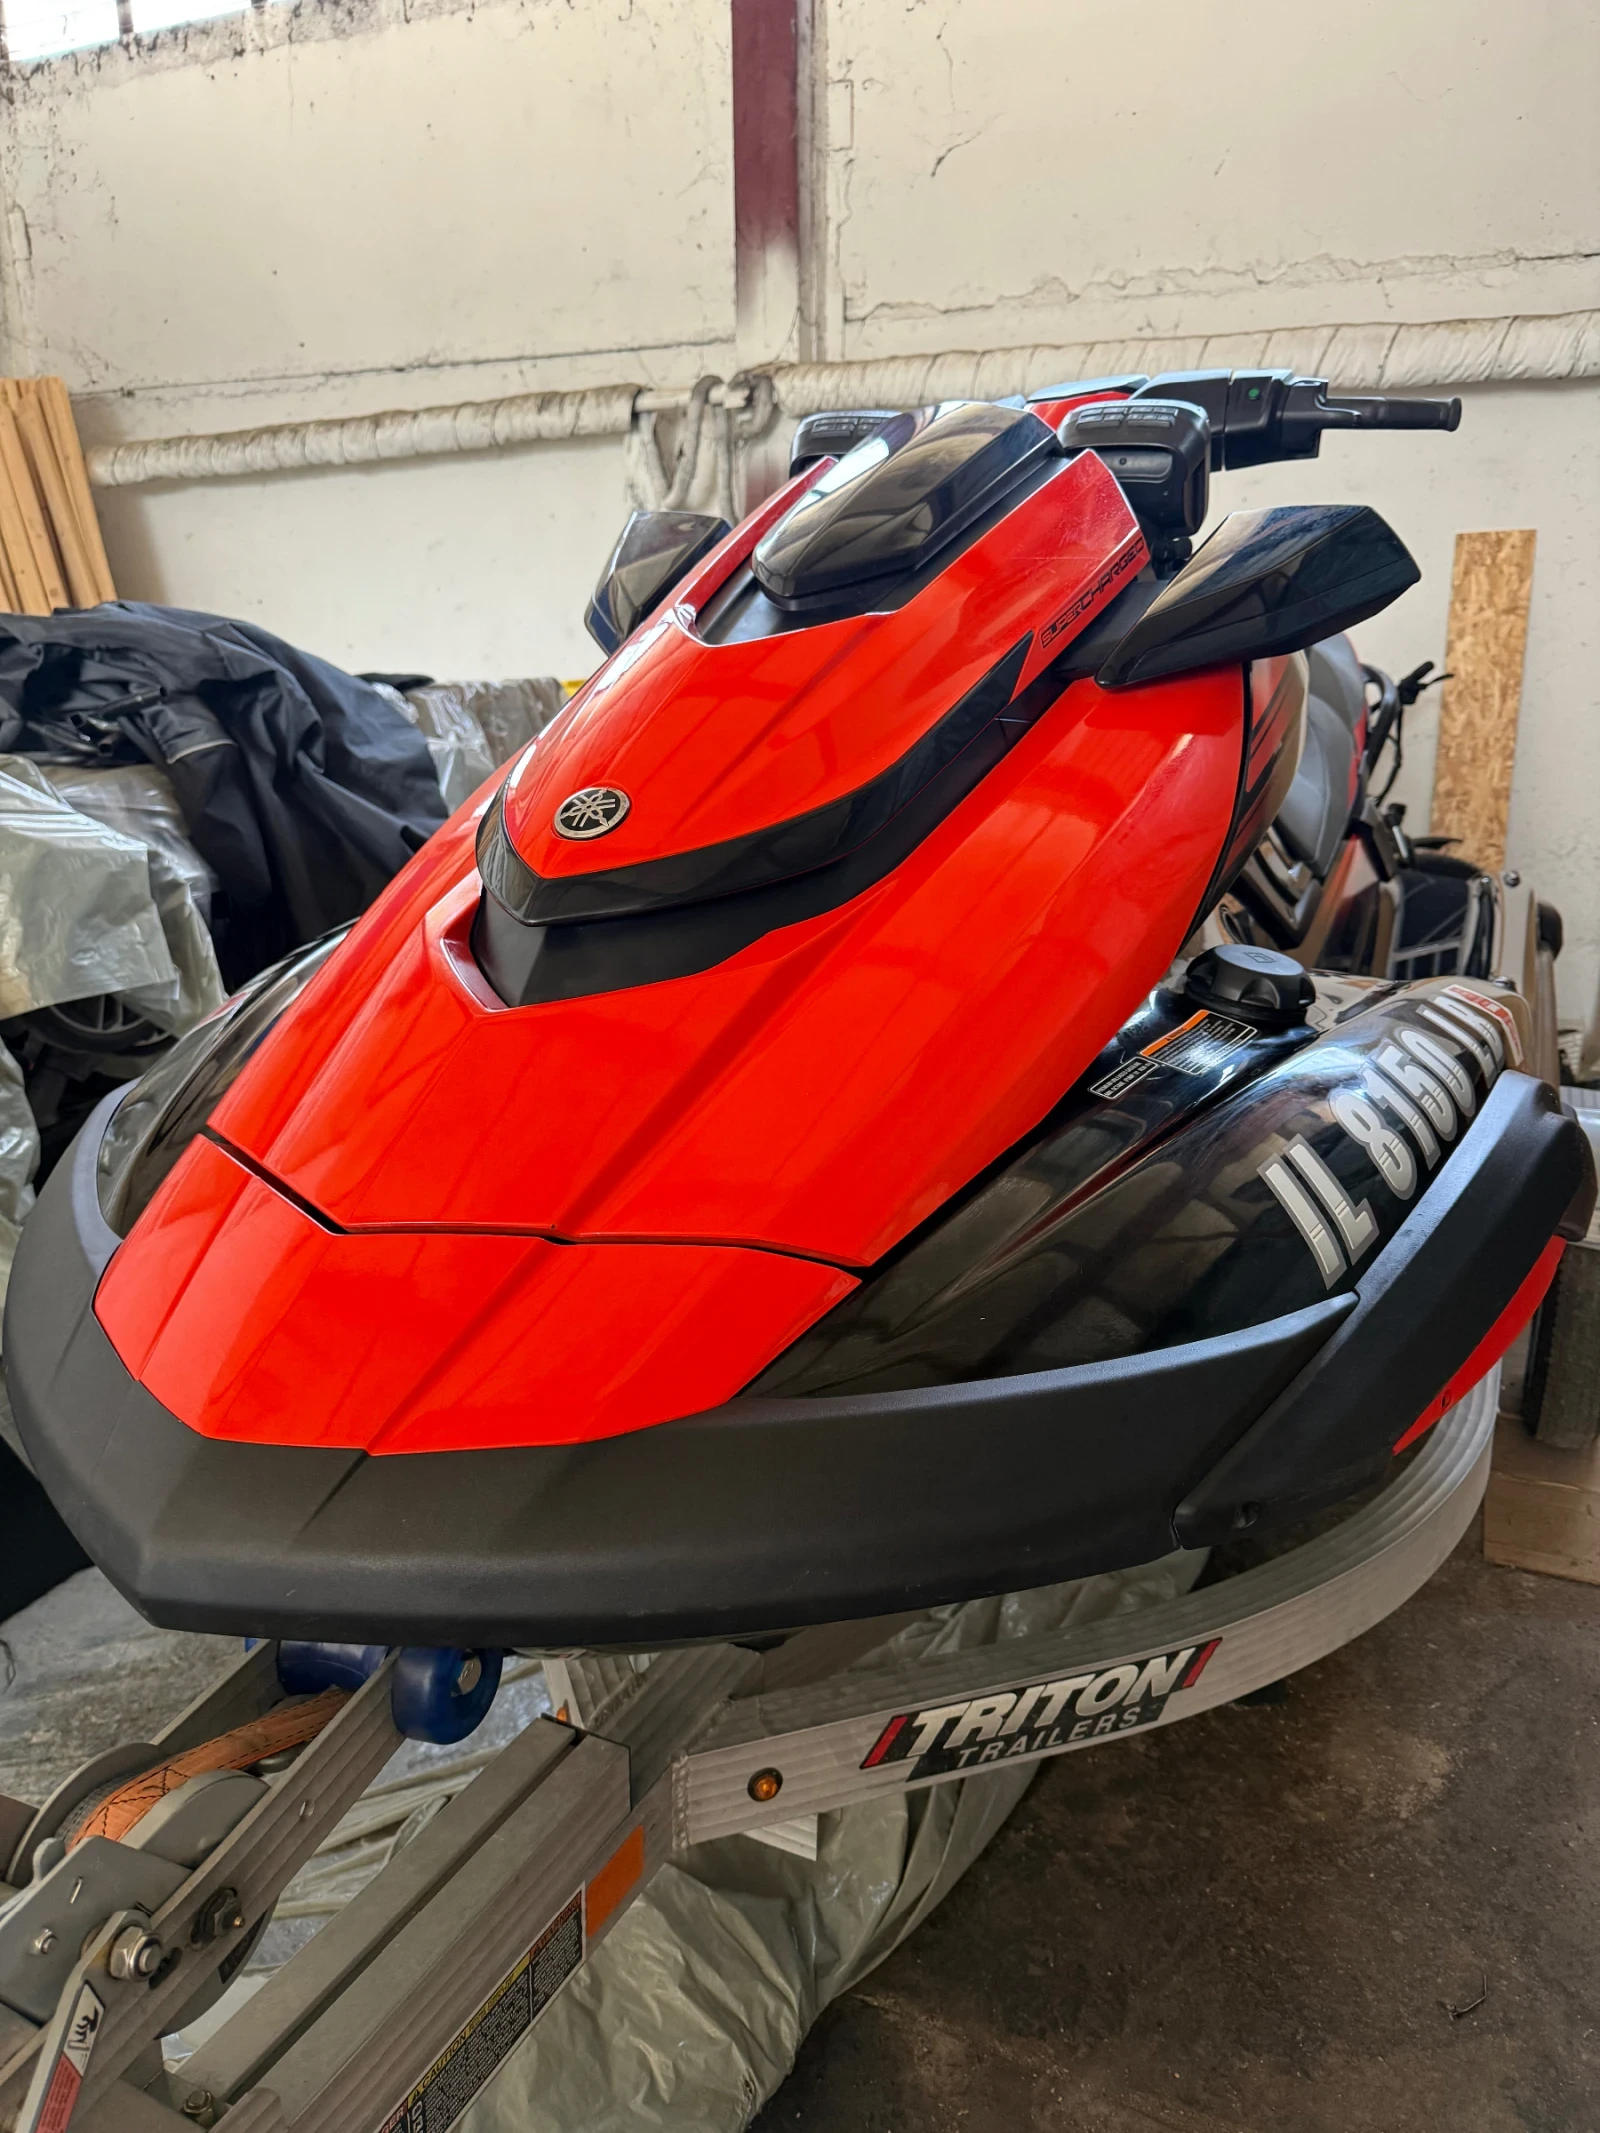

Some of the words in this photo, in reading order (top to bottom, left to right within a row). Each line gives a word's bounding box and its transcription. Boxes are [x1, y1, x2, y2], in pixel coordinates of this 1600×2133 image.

[1040, 535, 1145, 649] SUPERCHARGED
[1261, 1140, 1376, 1278] IL
[1334, 1029, 1474, 1193] 8150
[905, 1647, 1197, 1758] TRITON
[957, 1706, 1141, 1768] TRAILERS
[422, 2030, 468, 2090] CAUTION
